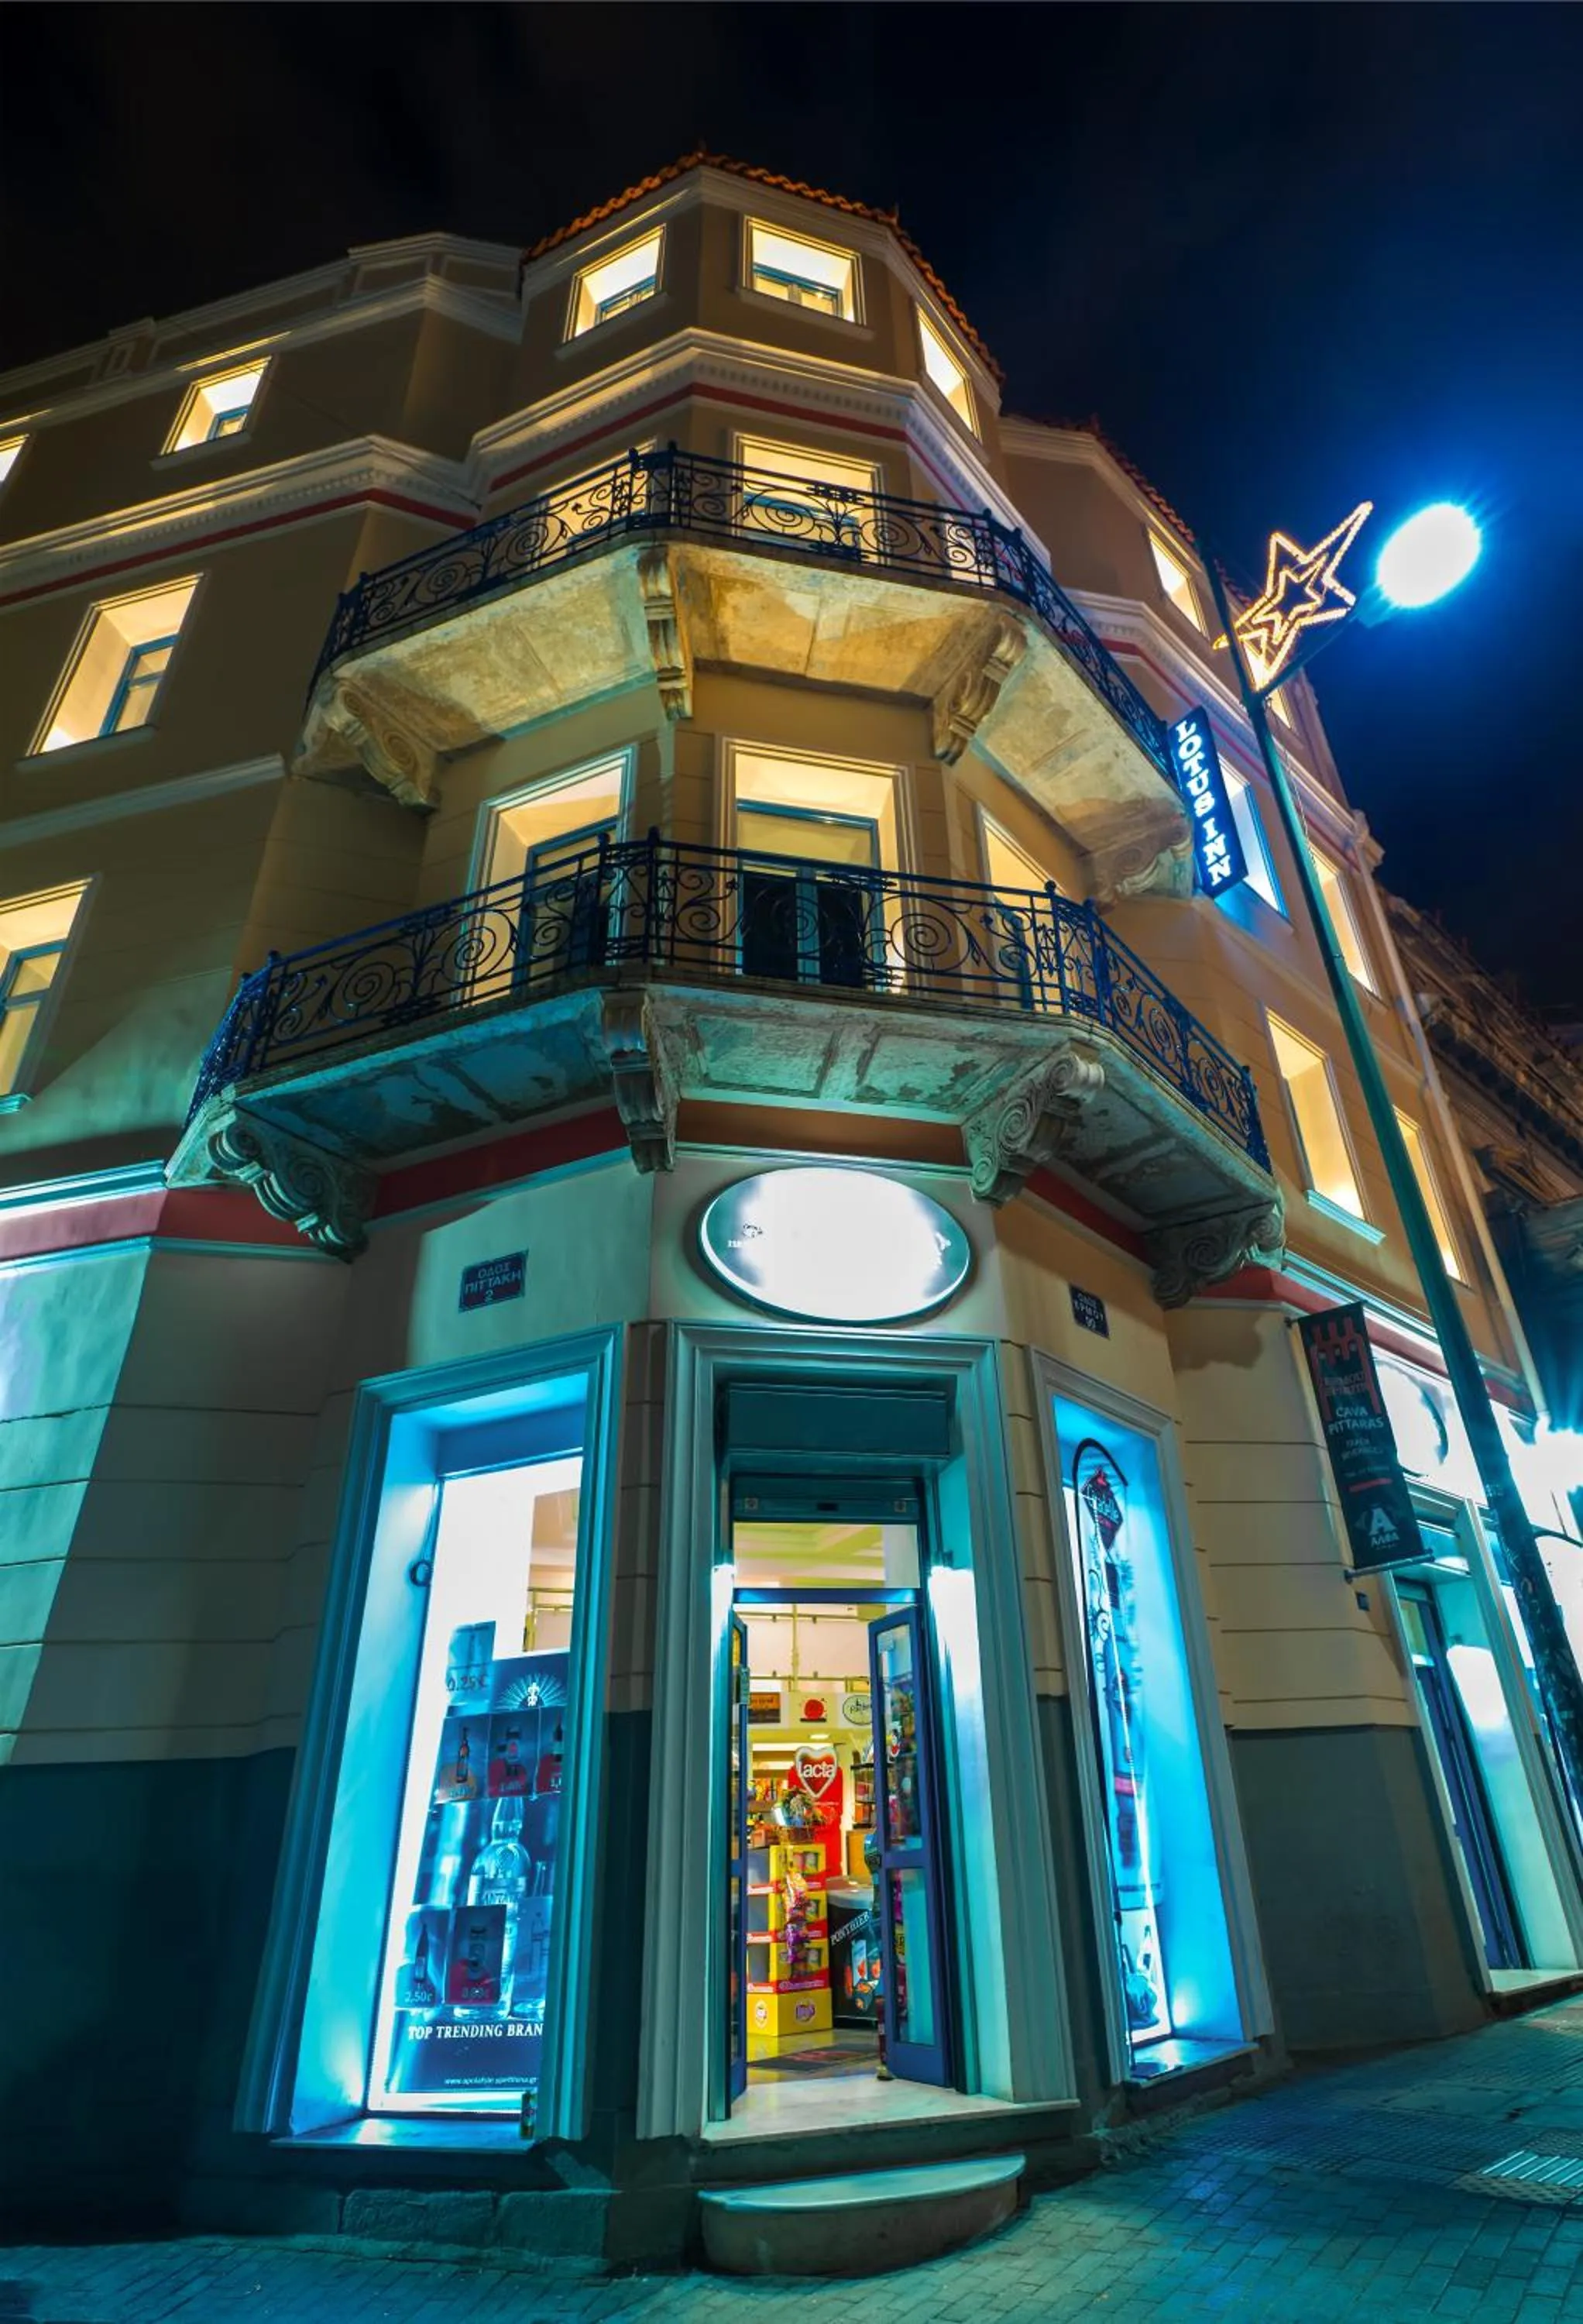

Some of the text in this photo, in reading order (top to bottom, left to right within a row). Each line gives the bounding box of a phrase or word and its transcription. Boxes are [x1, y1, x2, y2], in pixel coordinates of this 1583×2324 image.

[1176, 720, 1231, 886] LOTUS INN
[1335, 1405, 1368, 1418] CAVA
[1327, 1416, 1385, 1435] PITTARAS
[799, 1759, 836, 1779] lacta
[407, 2024, 433, 2040] TOP
[436, 2023, 503, 2039] TRENDING
